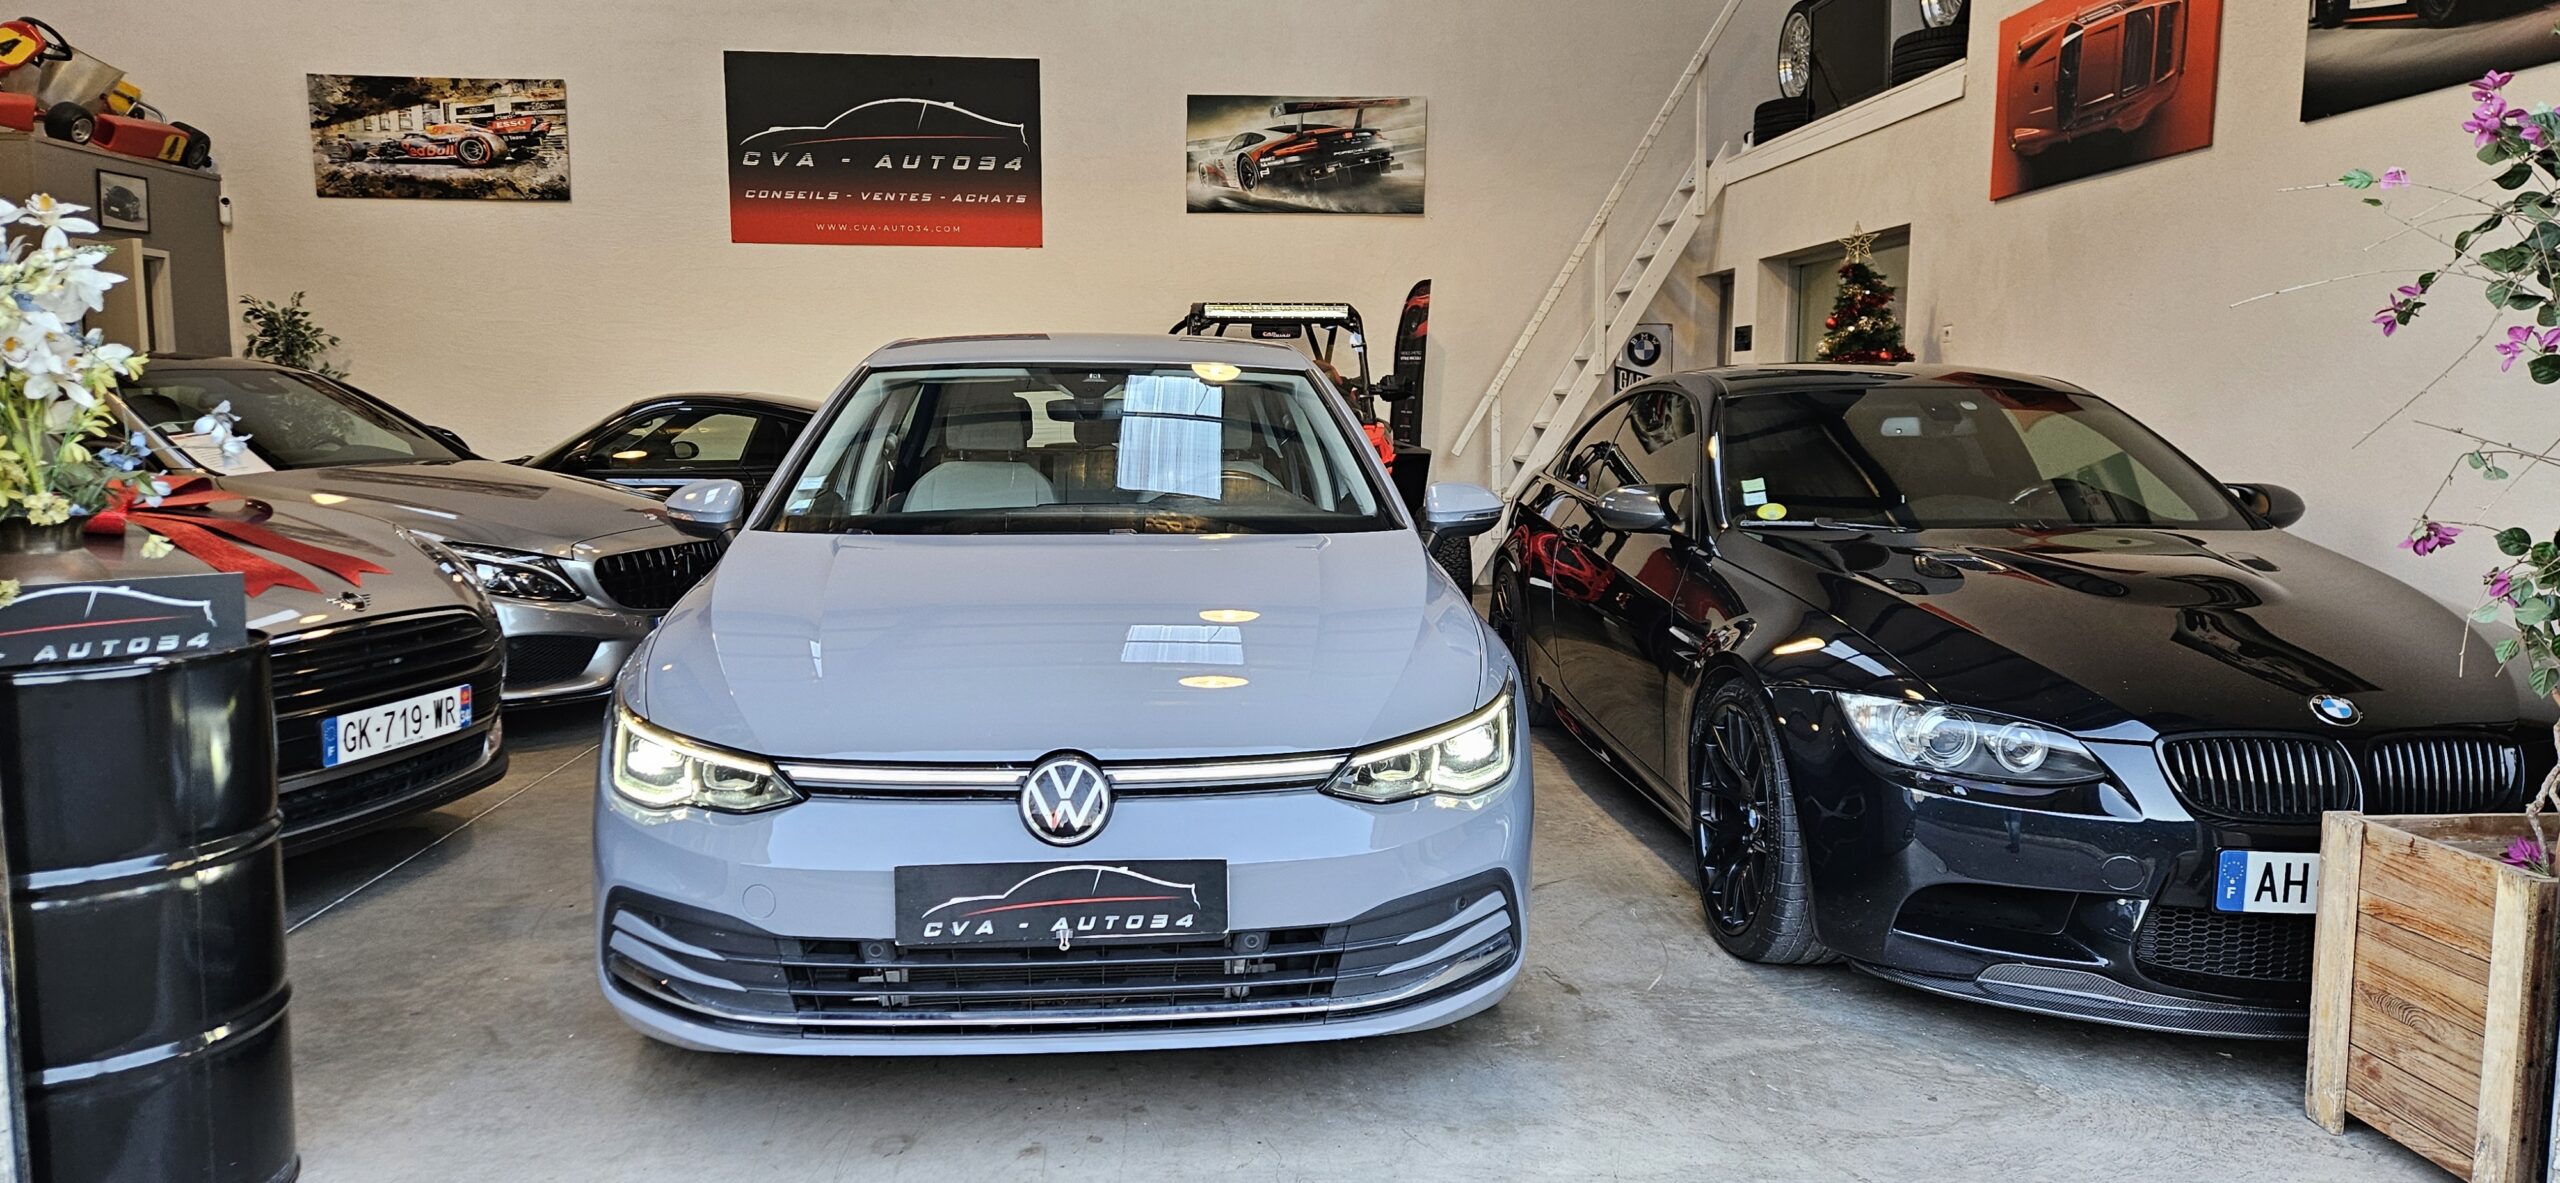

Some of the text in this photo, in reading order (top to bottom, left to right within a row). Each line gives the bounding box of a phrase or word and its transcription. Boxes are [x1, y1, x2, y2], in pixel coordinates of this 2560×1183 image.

[496, 119, 527, 128] ESSO
[742, 152, 816, 168] CVA
[874, 154, 1023, 171] AUTO34
[745, 190, 839, 201] CONSEILS
[860, 191, 932, 202] VENTES
[952, 194, 1027, 204] ACHATS
[816, 223, 961, 233] WWW.CVA-AUTO34.COM
[1630, 333, 1660, 346] BMW
[33, 632, 210, 662] AUTO34
[343, 696, 456, 752] GK-719-WR
[2226, 887, 2236, 899] F
[923, 919, 994, 938] CVA
[1050, 913, 1194, 932] AUTO34
